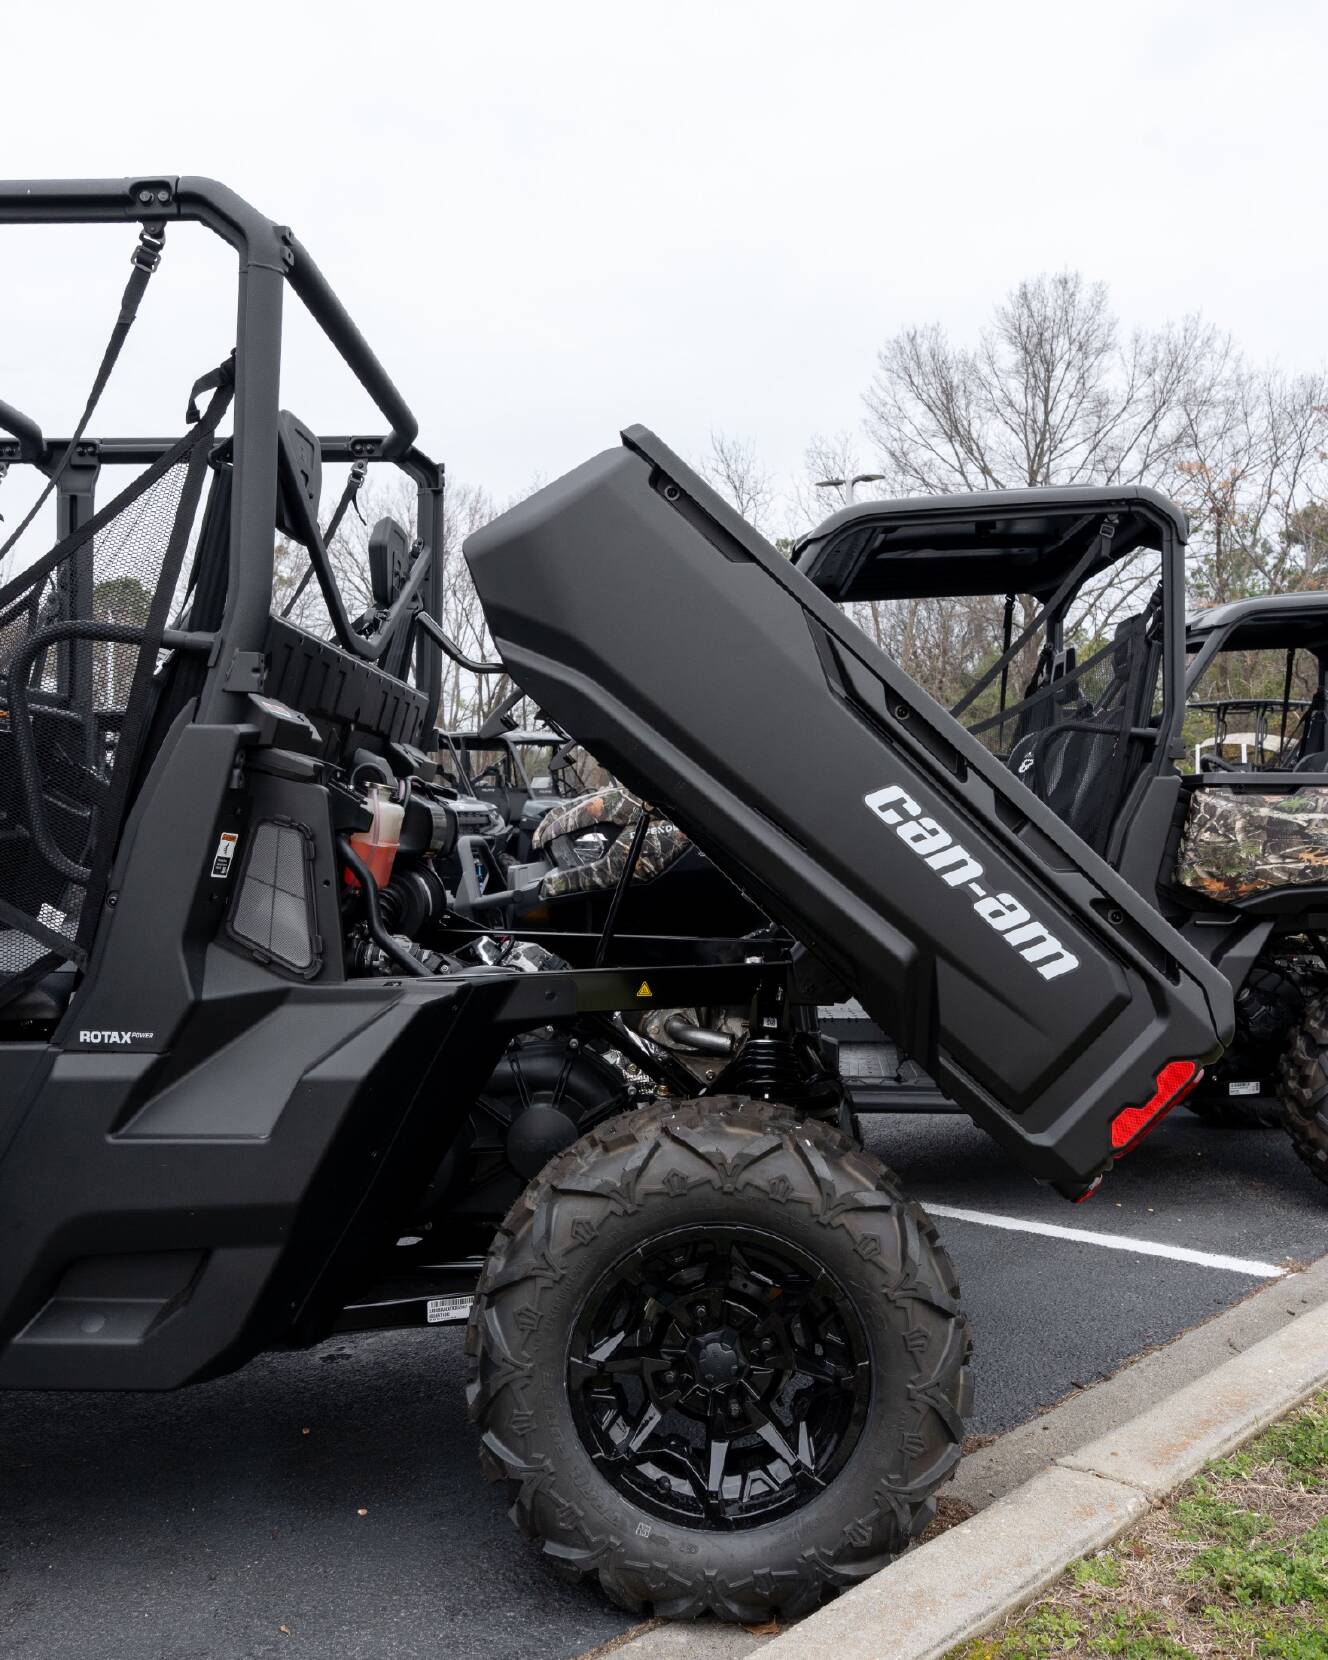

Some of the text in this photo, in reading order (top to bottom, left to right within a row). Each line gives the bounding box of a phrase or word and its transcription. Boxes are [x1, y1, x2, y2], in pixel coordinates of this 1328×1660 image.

[865, 785, 1079, 980] can-am
[79, 1030, 153, 1044] ROTAX POWER
